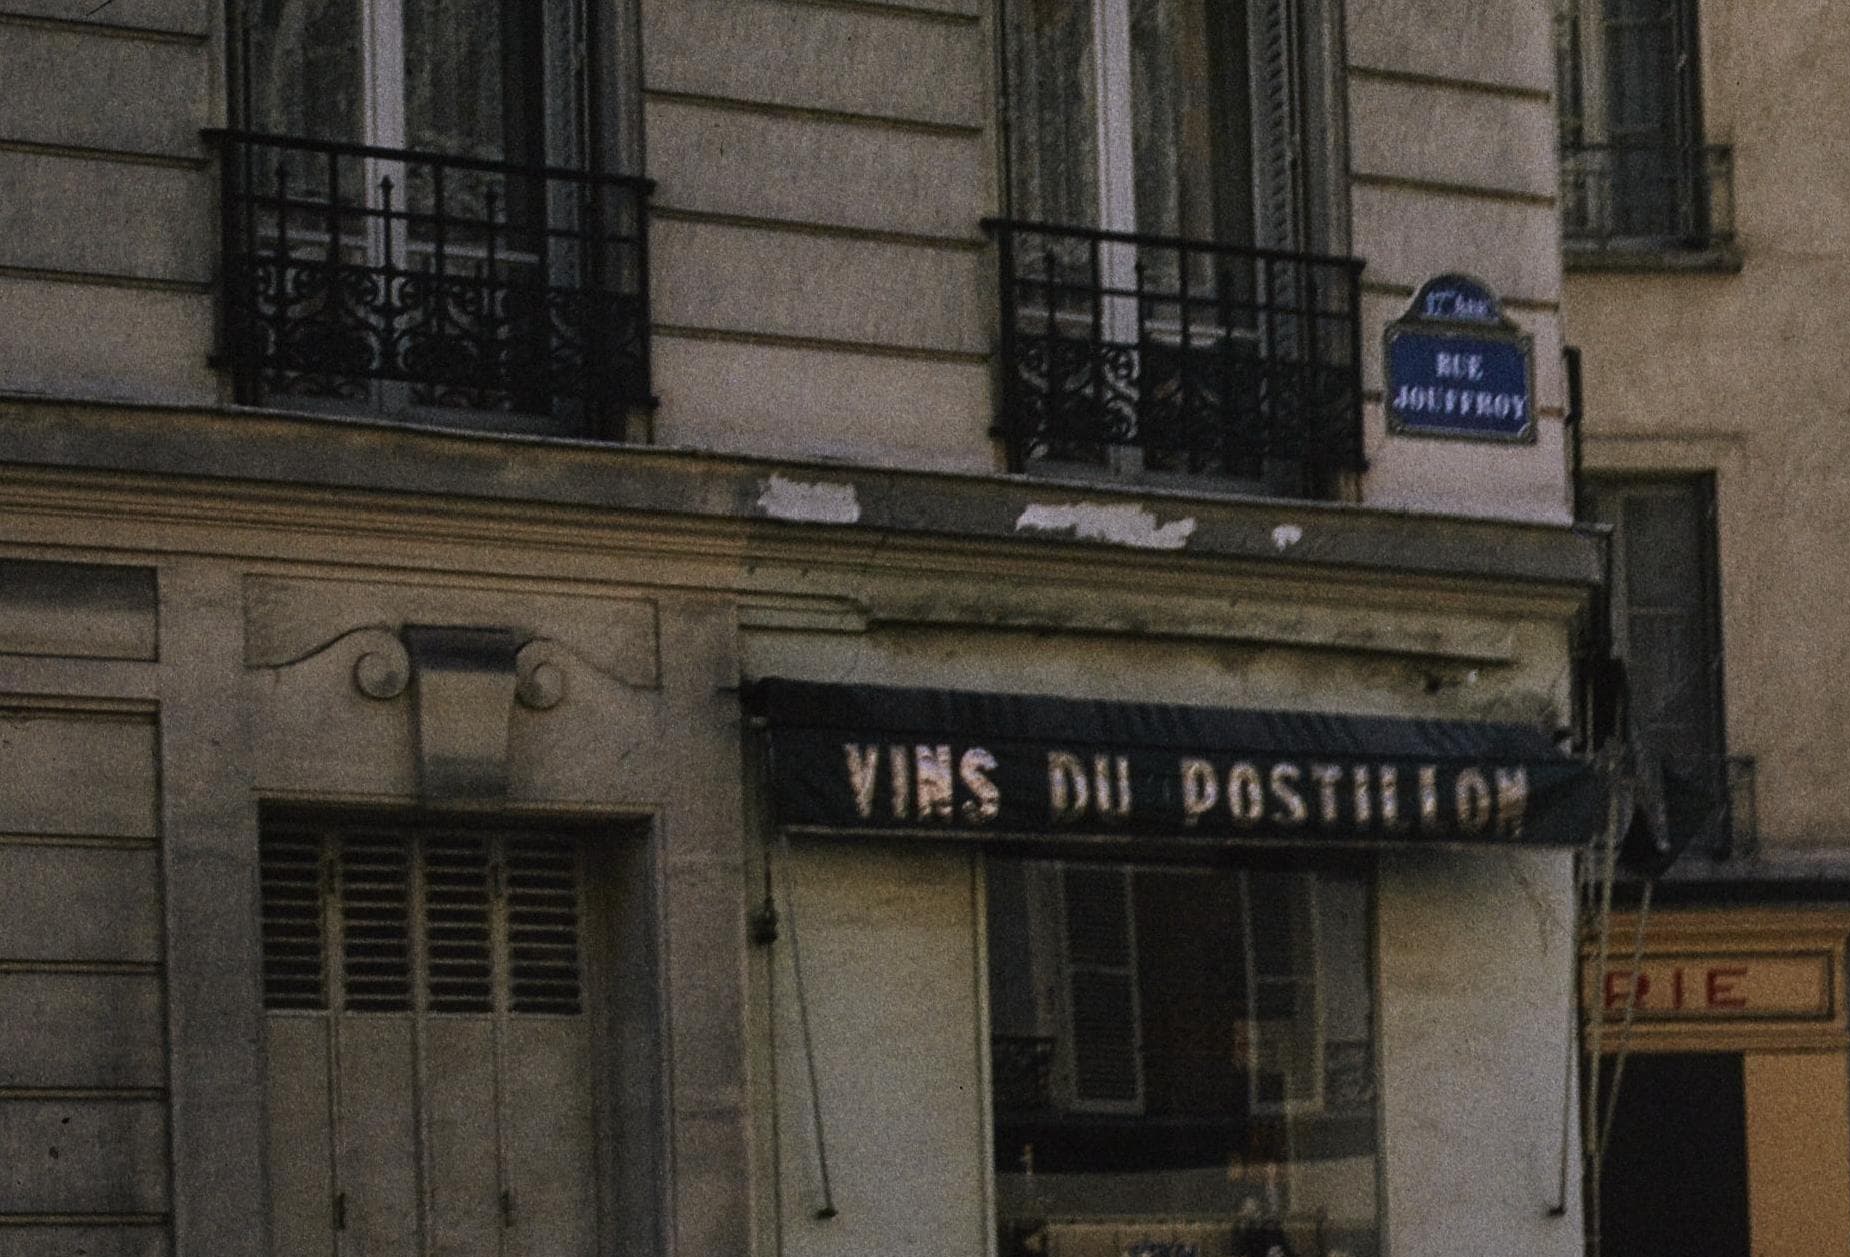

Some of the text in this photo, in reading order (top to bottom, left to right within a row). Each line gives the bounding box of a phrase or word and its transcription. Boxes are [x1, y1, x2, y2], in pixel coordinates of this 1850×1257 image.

[1436, 352, 1483, 381] RUE
[1393, 385, 1526, 420] JOUFFROY
[843, 744, 1529, 837] VINS DU POSTILLON
